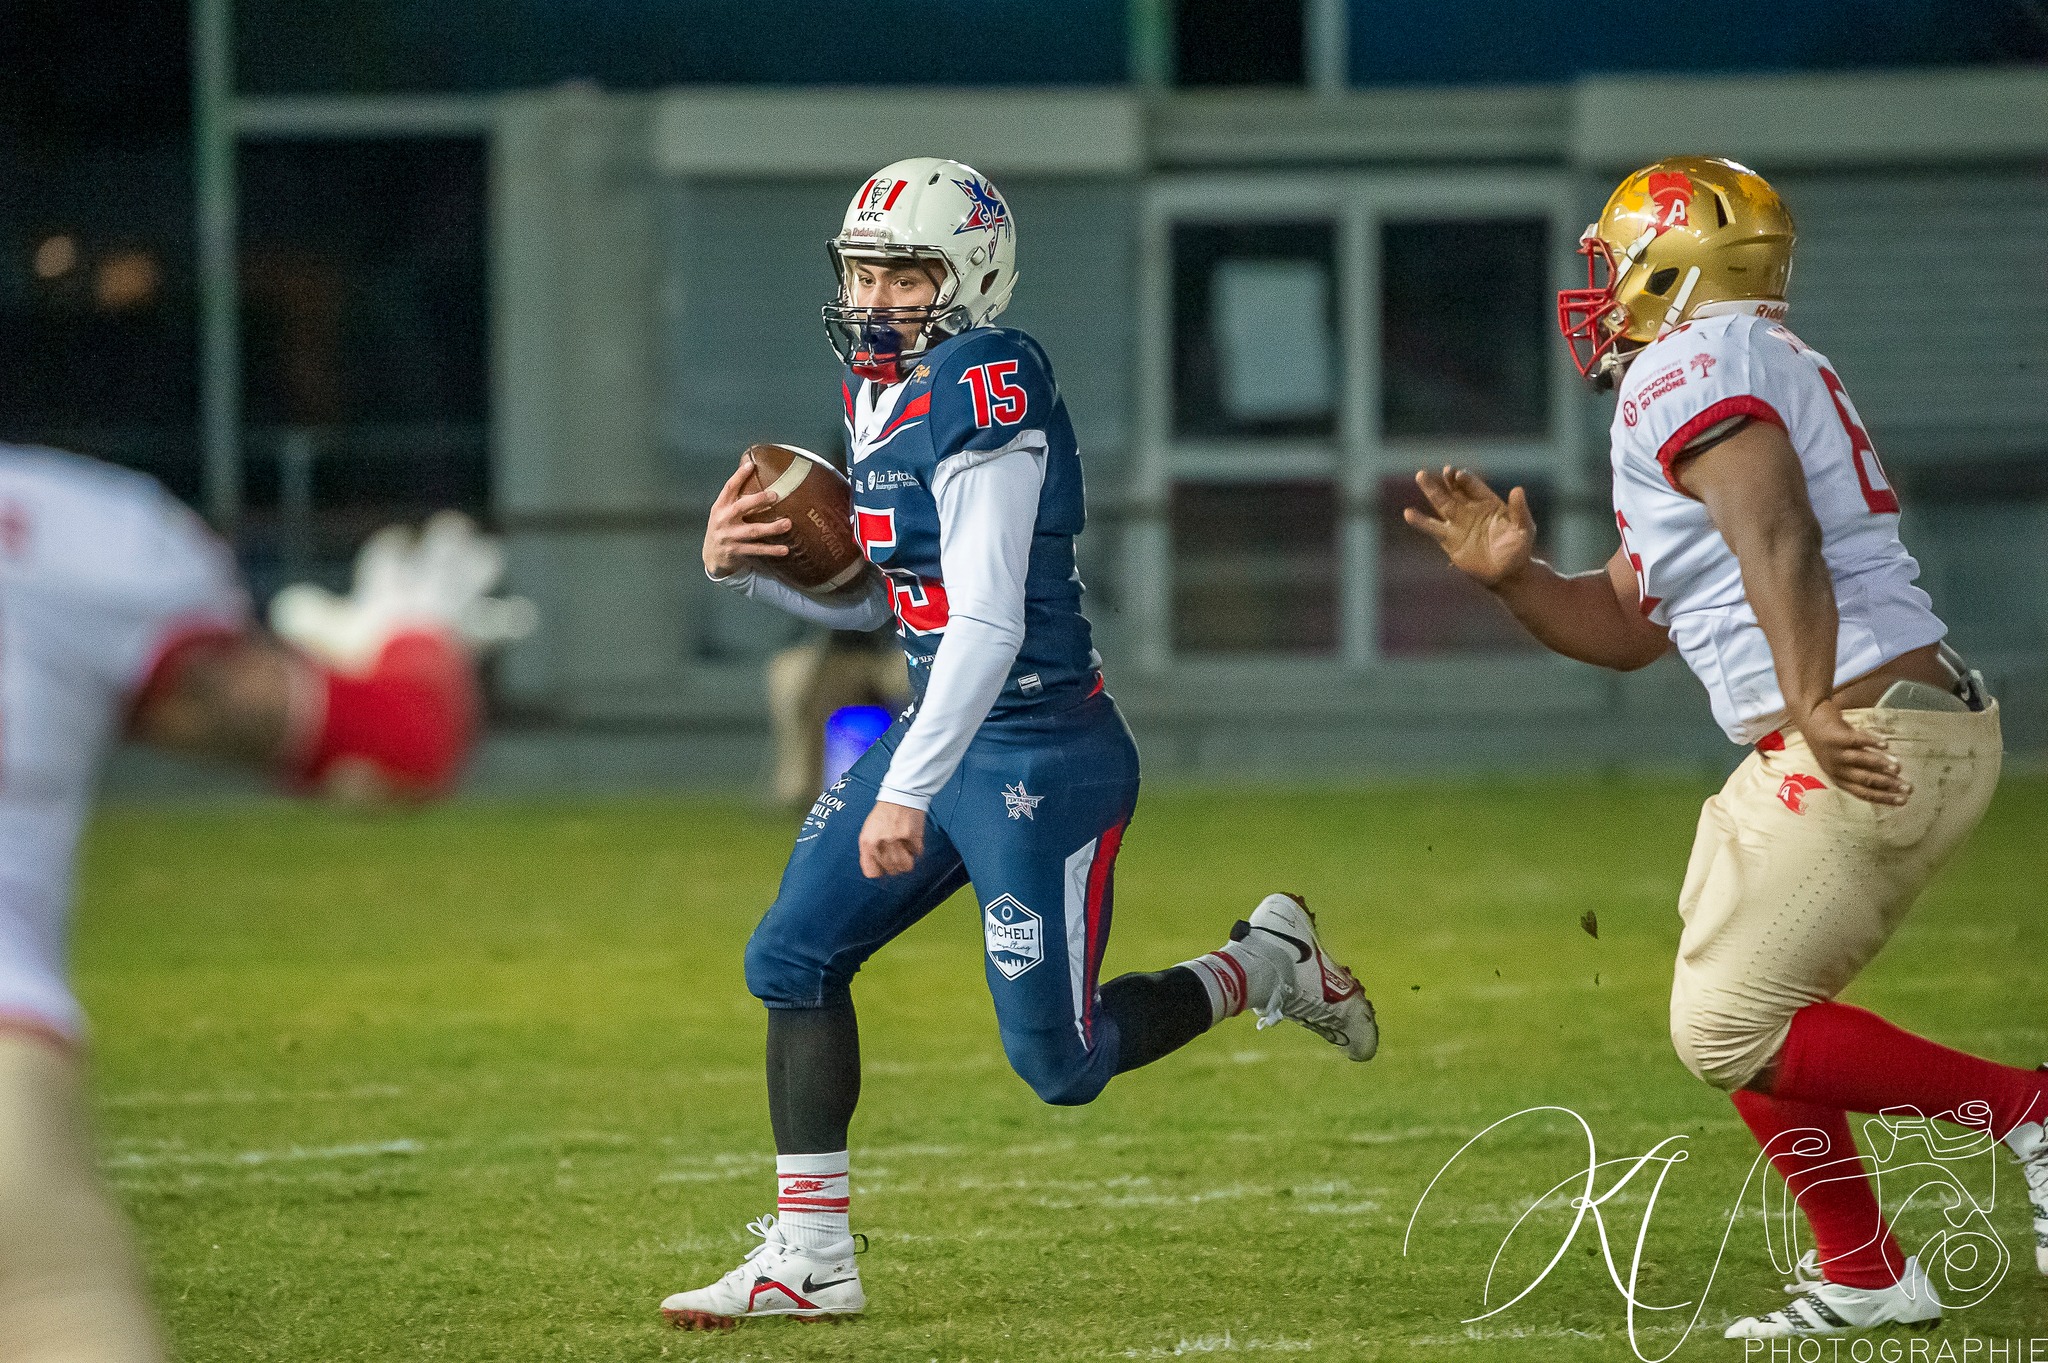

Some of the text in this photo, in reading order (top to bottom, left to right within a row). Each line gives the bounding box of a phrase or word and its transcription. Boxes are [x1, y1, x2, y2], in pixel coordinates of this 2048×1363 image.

[857, 210, 884, 222] KFC
[1662, 198, 1686, 226] A
[1754, 304, 1785, 319] Ridd
[957, 359, 1028, 429] 15
[988, 921, 1034, 940] MICHELI
[793, 1180, 825, 1191] NIKE
